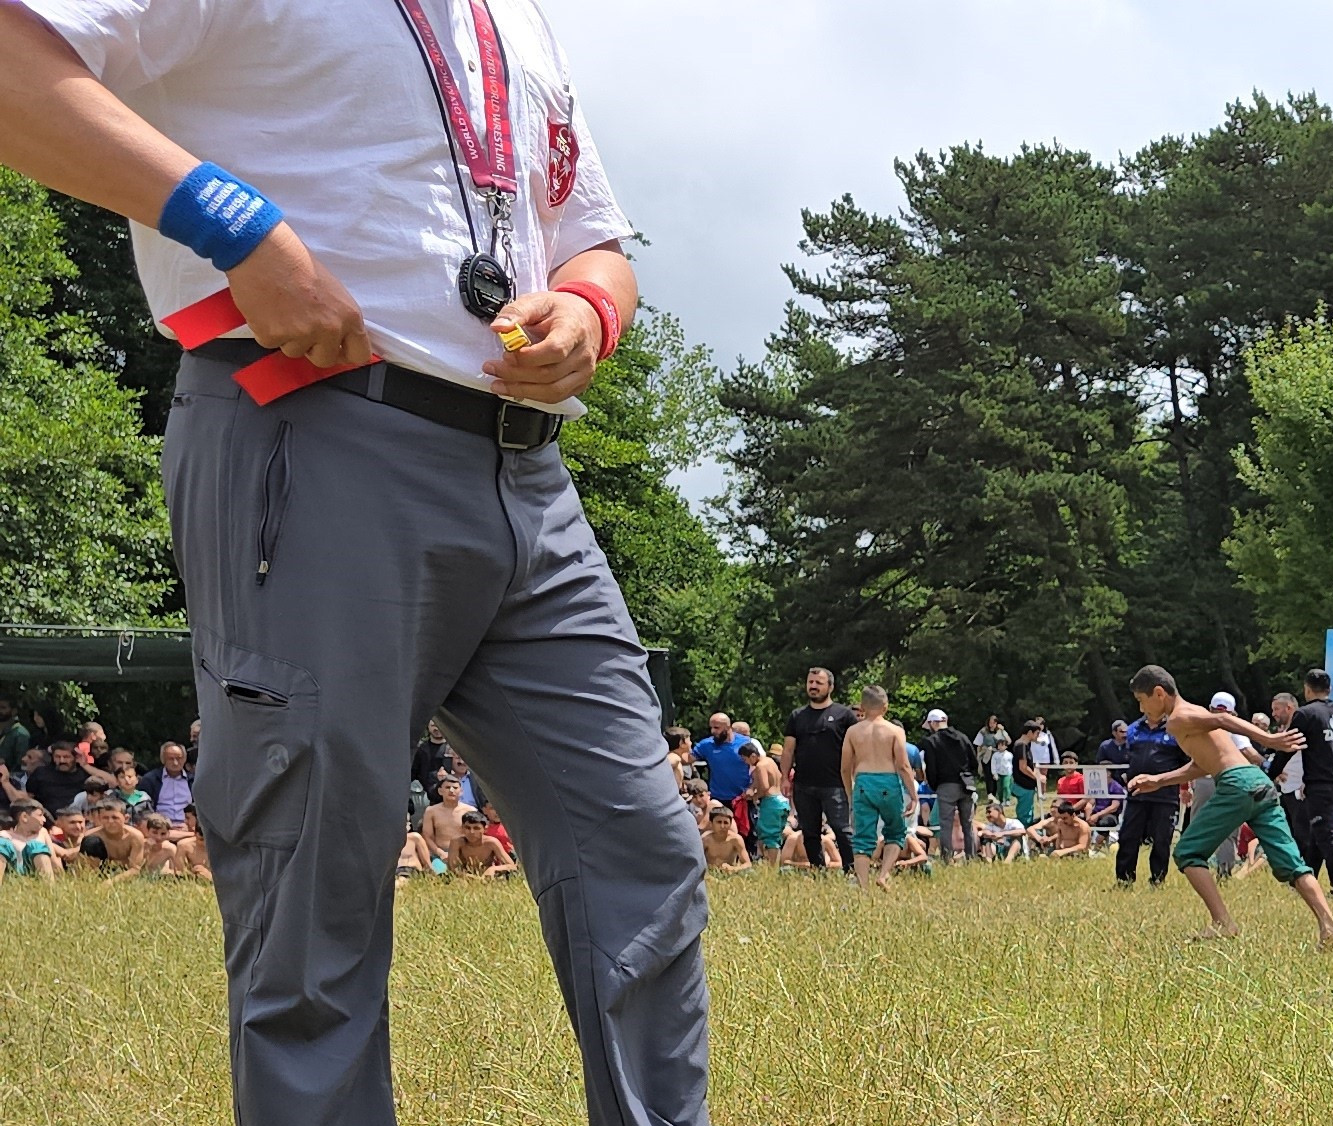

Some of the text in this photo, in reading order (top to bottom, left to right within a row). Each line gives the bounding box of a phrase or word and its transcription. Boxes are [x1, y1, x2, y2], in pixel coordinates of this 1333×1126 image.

[438, 66, 463, 116] OLYMPIC
[483, 40, 507, 172] UNITED WORLD WRESTLING
[458, 117, 479, 160] WORLD
